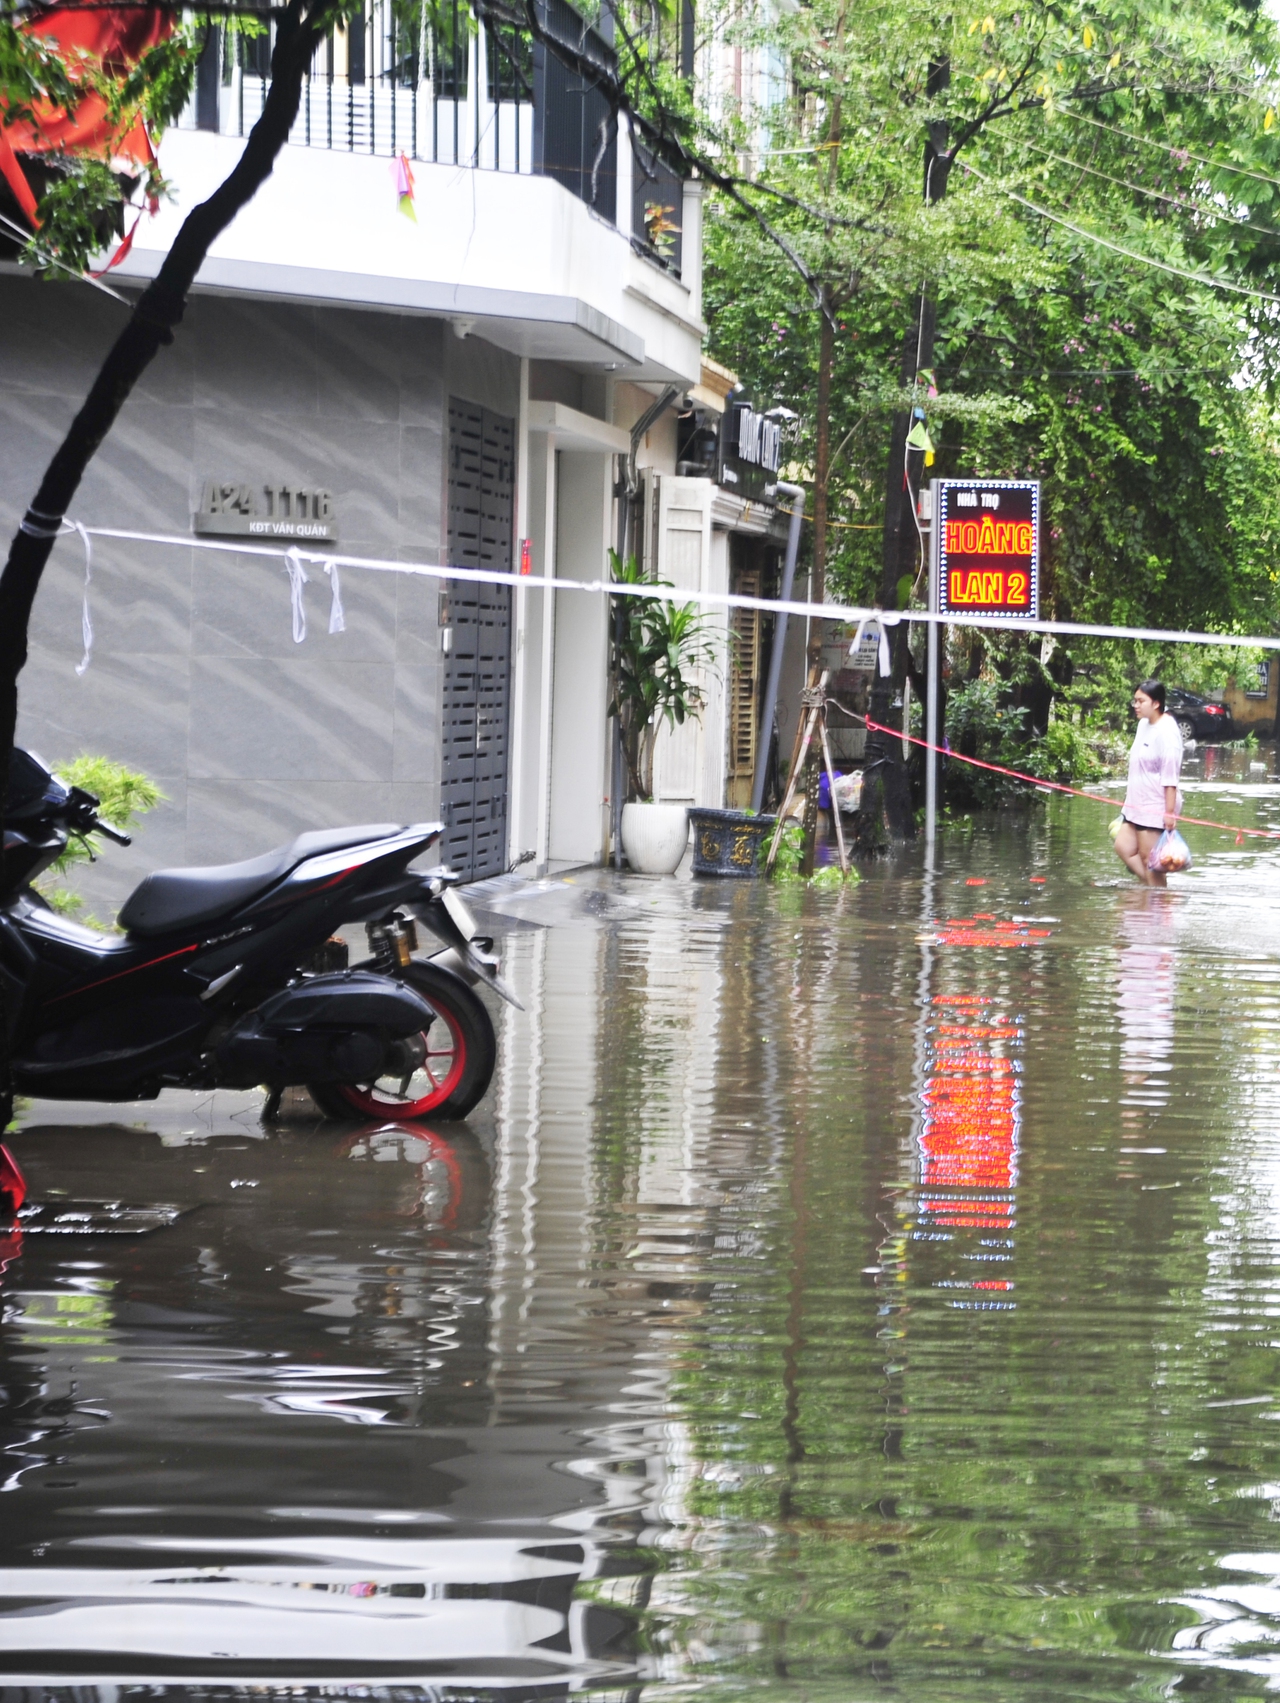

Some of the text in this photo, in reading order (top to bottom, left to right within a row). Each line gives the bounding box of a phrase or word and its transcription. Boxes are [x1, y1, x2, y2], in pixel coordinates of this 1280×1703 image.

[957, 489, 1000, 511] NHÀ TRỌ
[249, 521, 327, 536] KĐT VĂN QUÁN
[944, 516, 1033, 555] HOÀNG
[951, 571, 1026, 604] LAN 2
